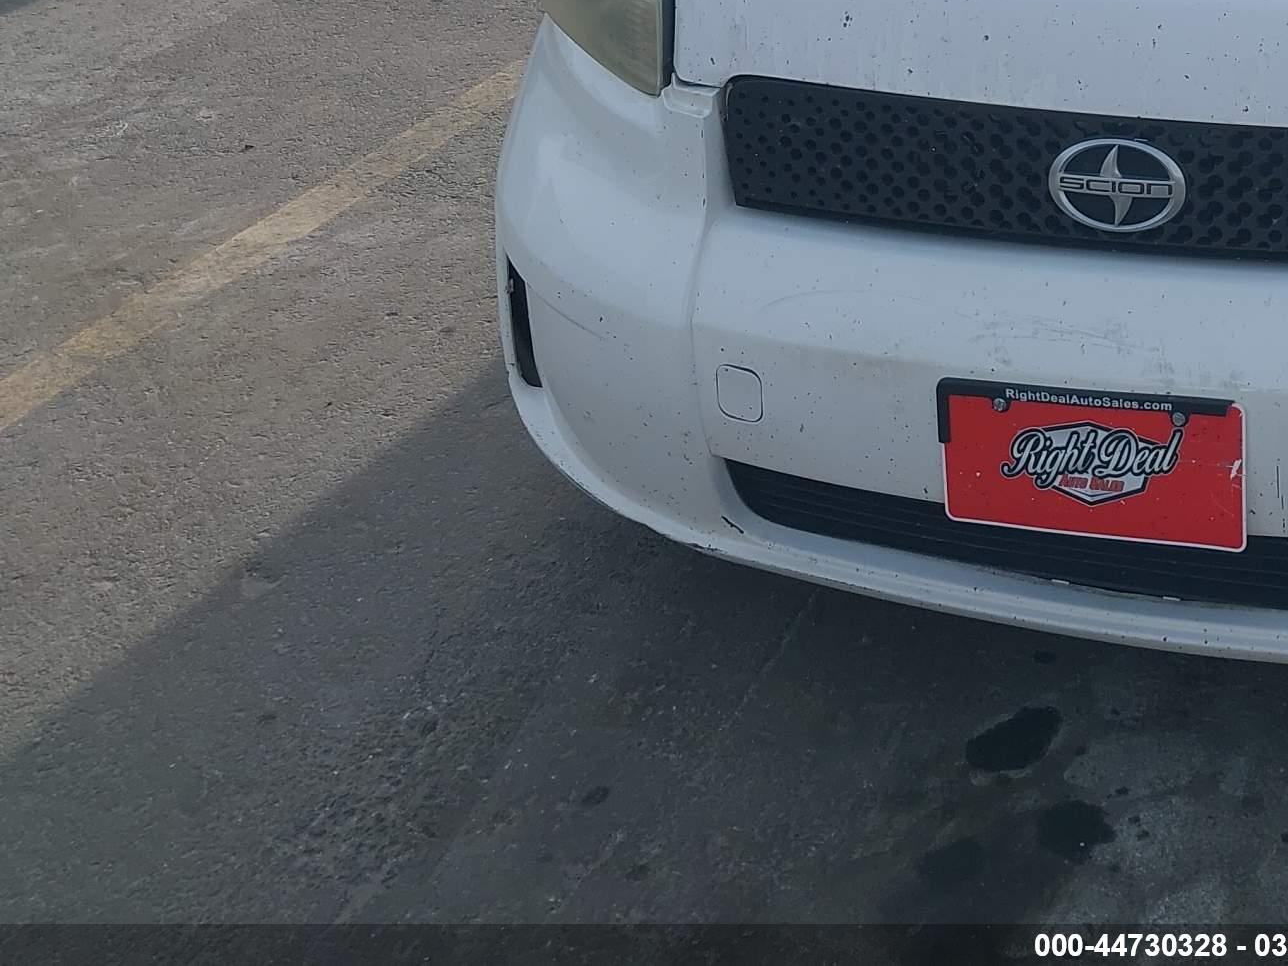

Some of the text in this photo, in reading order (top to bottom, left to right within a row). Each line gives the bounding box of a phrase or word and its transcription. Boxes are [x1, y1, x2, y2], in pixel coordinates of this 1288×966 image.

[1005, 388, 1173, 411] RightDealAutoSales.com
[1001, 427, 1184, 489] Right Deal
